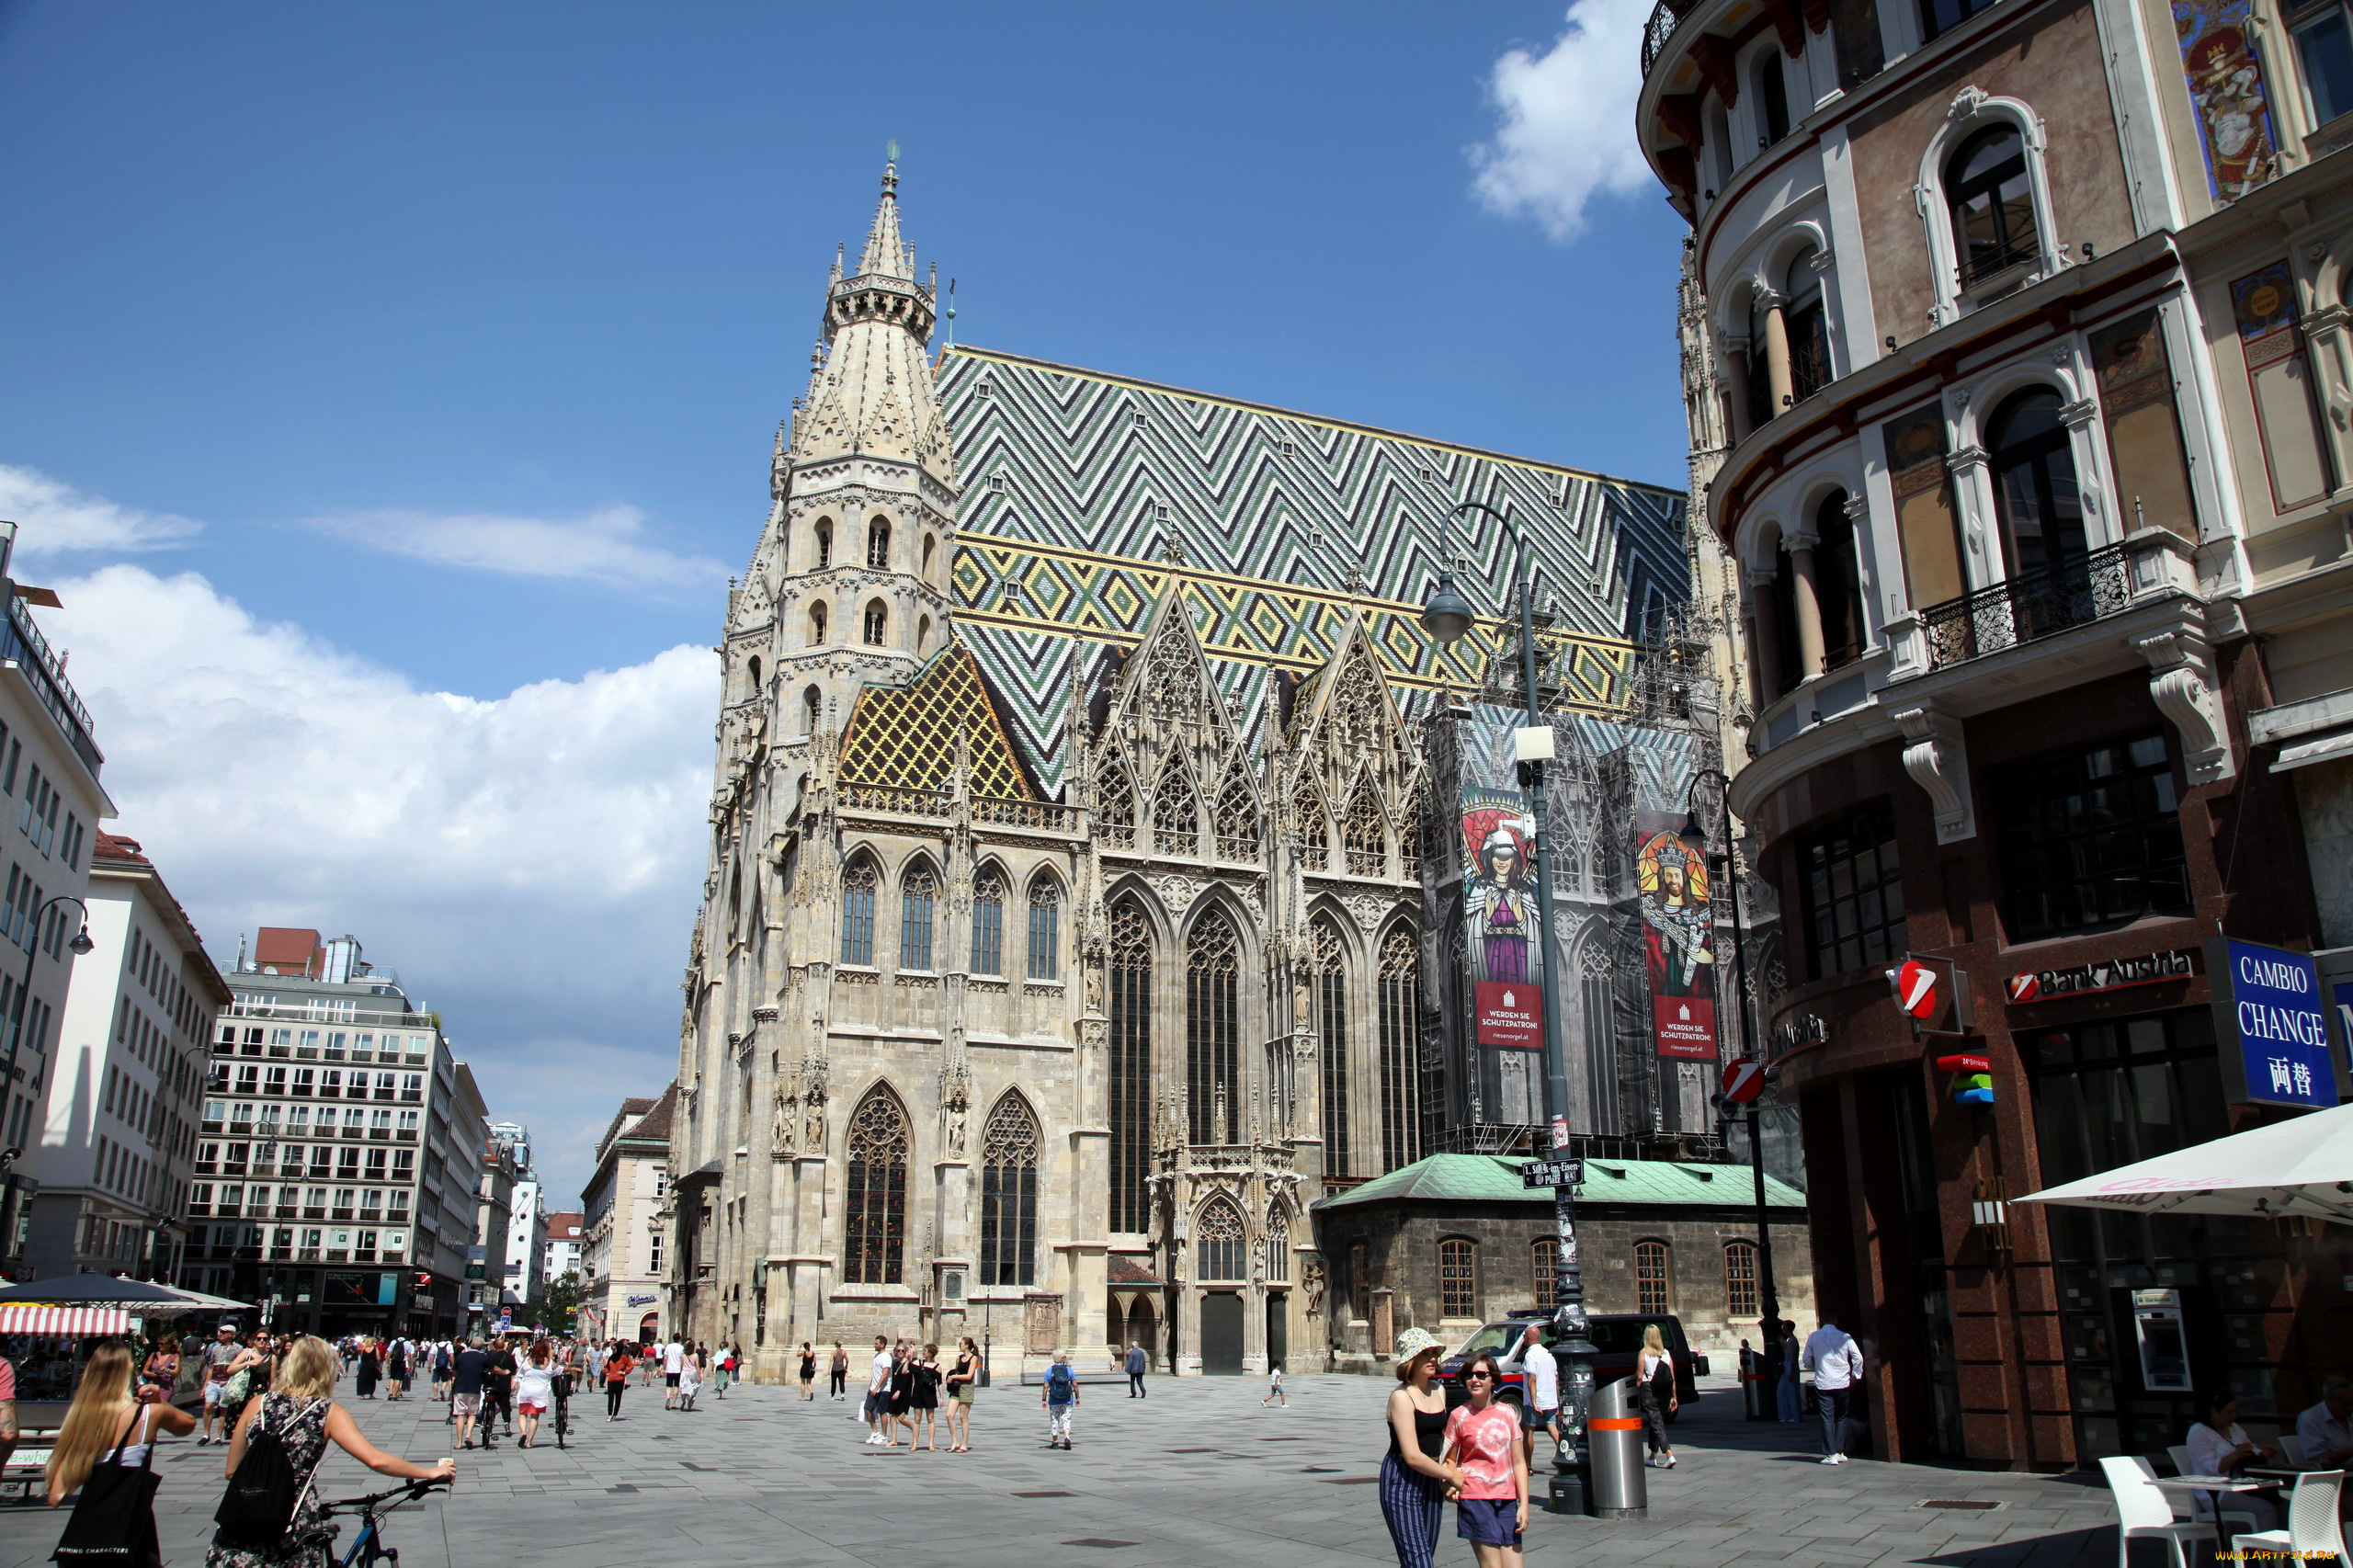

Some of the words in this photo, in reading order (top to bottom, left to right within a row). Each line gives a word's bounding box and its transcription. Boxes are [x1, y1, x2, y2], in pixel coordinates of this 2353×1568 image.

[2040, 962, 2100, 995] Bank
[2105, 949, 2192, 985] Austria
[2240, 956, 2308, 994] CAMBIO
[1489, 1010, 1518, 1019] WERDEN
[1519, 1012, 1530, 1020] SIE
[1482, 1018, 1538, 1029] SCHUTZPATRON!
[1666, 1023, 1693, 1031] WERDEN
[2238, 1001, 2327, 1047] CHANGE
[1493, 1031, 1529, 1041] riesenorgel.at
[1660, 1030, 1711, 1041] SCHUTZPATRON!
[1670, 1043, 1704, 1052] riesenorgel.at
[2267, 1057, 2313, 1096] 両替
[1545, 1174, 1561, 1184] Platz
